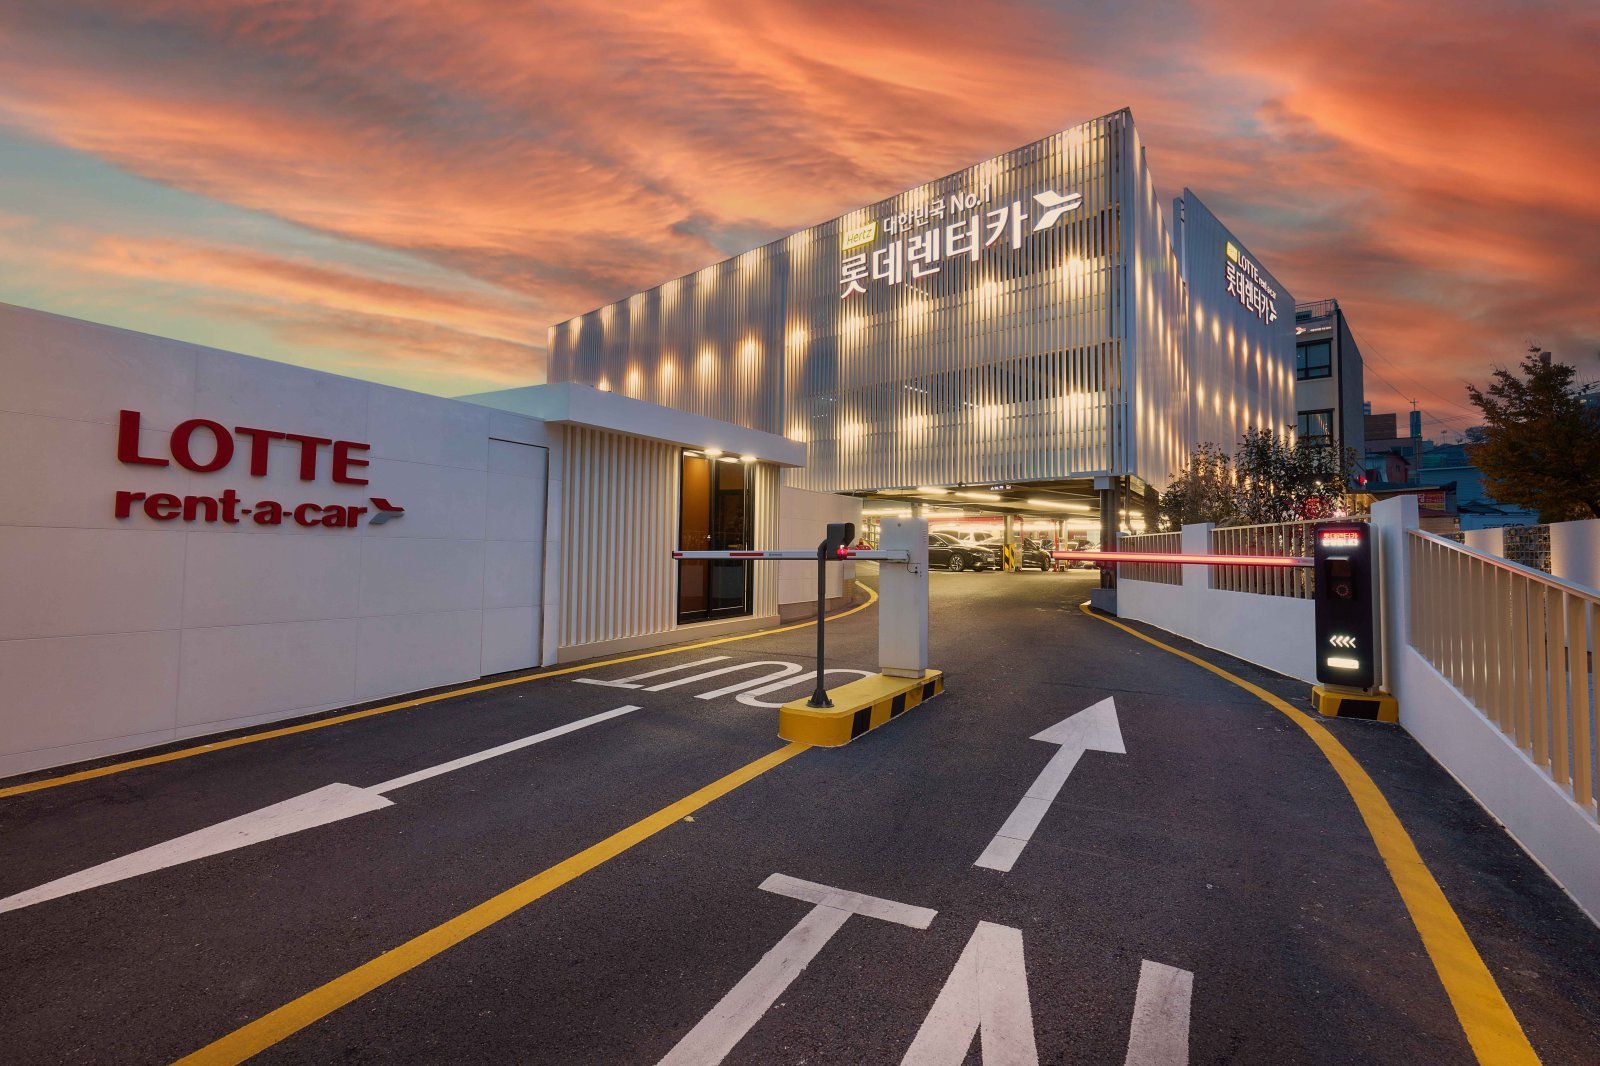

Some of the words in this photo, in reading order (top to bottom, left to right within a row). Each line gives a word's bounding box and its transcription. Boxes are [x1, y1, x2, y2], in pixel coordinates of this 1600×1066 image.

[883, 198, 946, 236] 대한민국
[950, 183, 991, 215] No.1
[840, 200, 1028, 300] 롯데렌터카
[846, 228, 873, 245] Hertz
[1226, 260, 1269, 325] 롯데렌터카
[1237, 251, 1259, 283] LOTTE
[117, 409, 371, 486] LOTTE
[114, 489, 368, 528] rent-a-car
